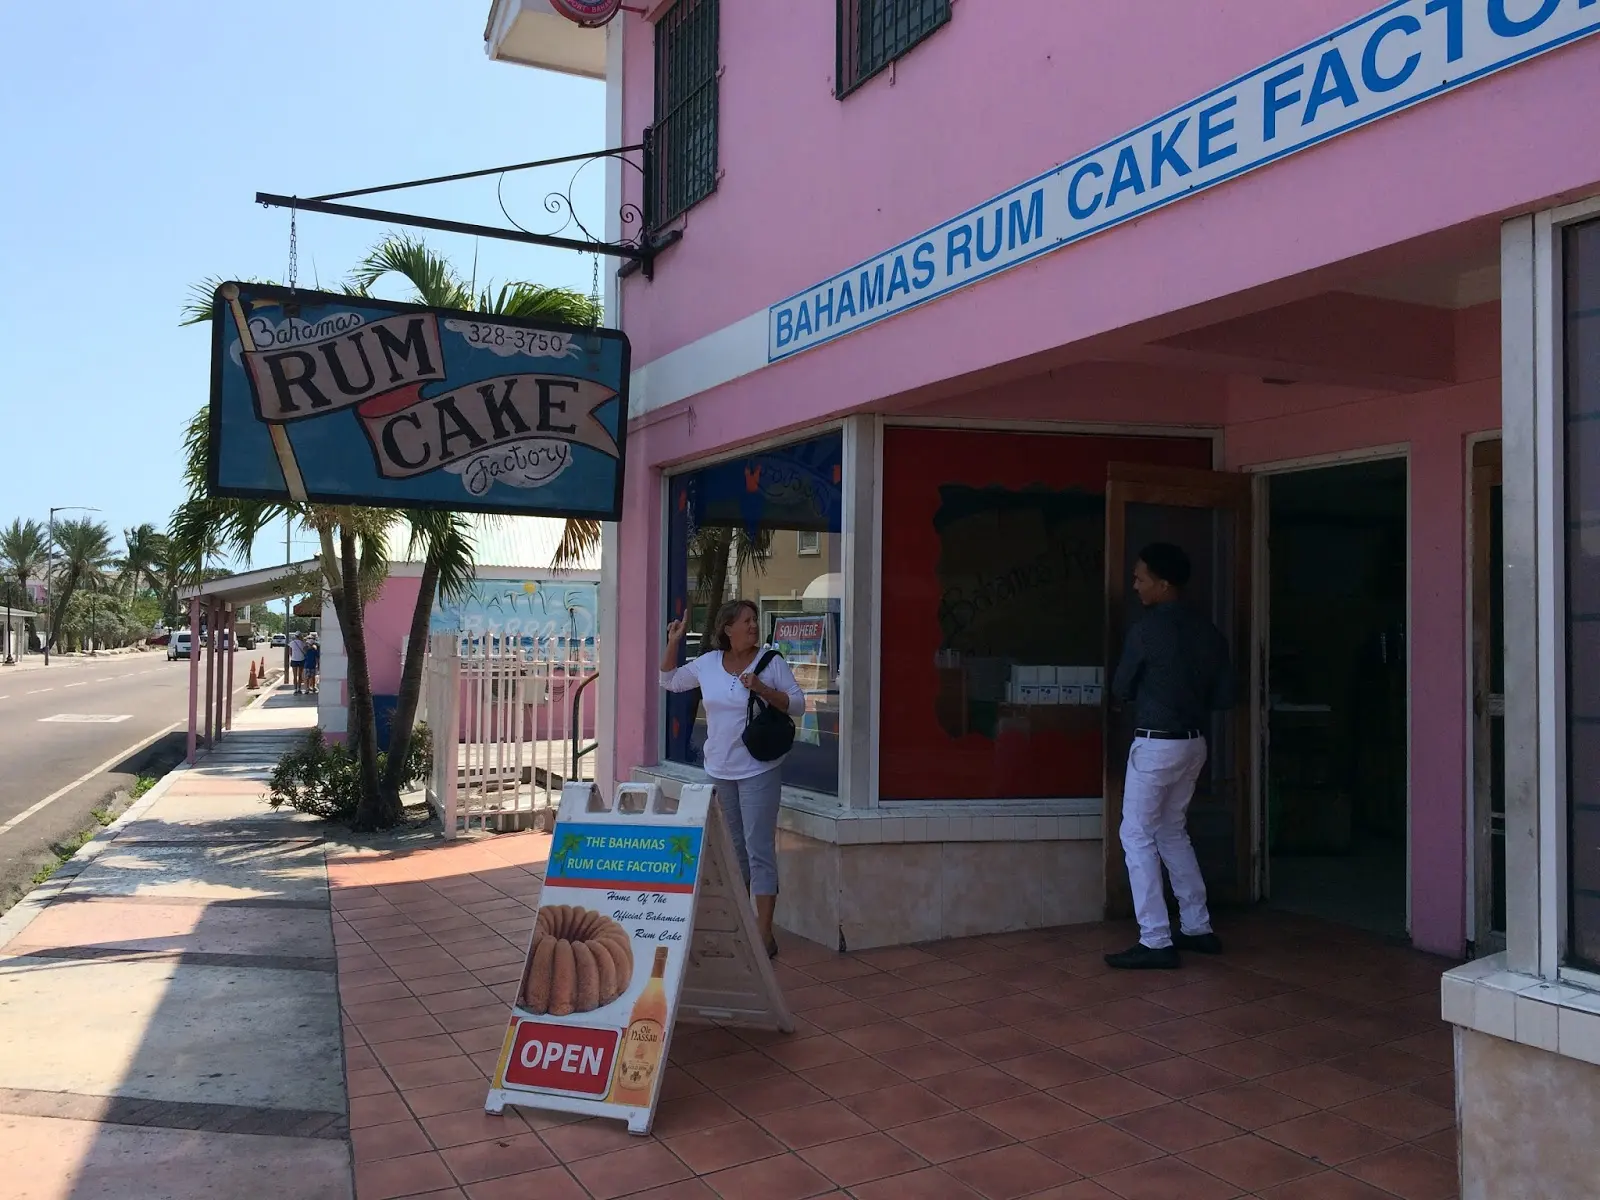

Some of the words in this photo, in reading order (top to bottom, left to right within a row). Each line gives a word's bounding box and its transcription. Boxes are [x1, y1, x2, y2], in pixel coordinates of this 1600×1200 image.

[774, 242, 936, 349] BAHAMAS
[945, 189, 1045, 277] RUM
[1067, 96, 1239, 221] CAKE
[1263, 0, 1600, 142] FACT
[248, 313, 361, 349] Bahamas
[468, 322, 563, 354] 328-3750
[263, 318, 437, 412] RUM
[381, 378, 580, 468] CAKE
[465, 444, 568, 495] Factory
[779, 625, 798, 637] SOLD
[799, 624, 818, 637] HERE
[586, 836, 606, 848] THE
[608, 837, 665, 850] BAHAMAS
[567, 858, 594, 870] RUM
[596, 859, 624, 871] CAKE
[626, 860, 677, 874] FACTORY
[606, 891, 631, 902] Home
[637, 893, 648, 905] Of
[651, 893, 667, 904] The
[612, 910, 643, 922] Official
[645, 911, 686, 923] Bahamian
[634, 928, 656, 939] Rum
[658, 930, 682, 941] Cake
[520, 1038, 604, 1076] OPEN
